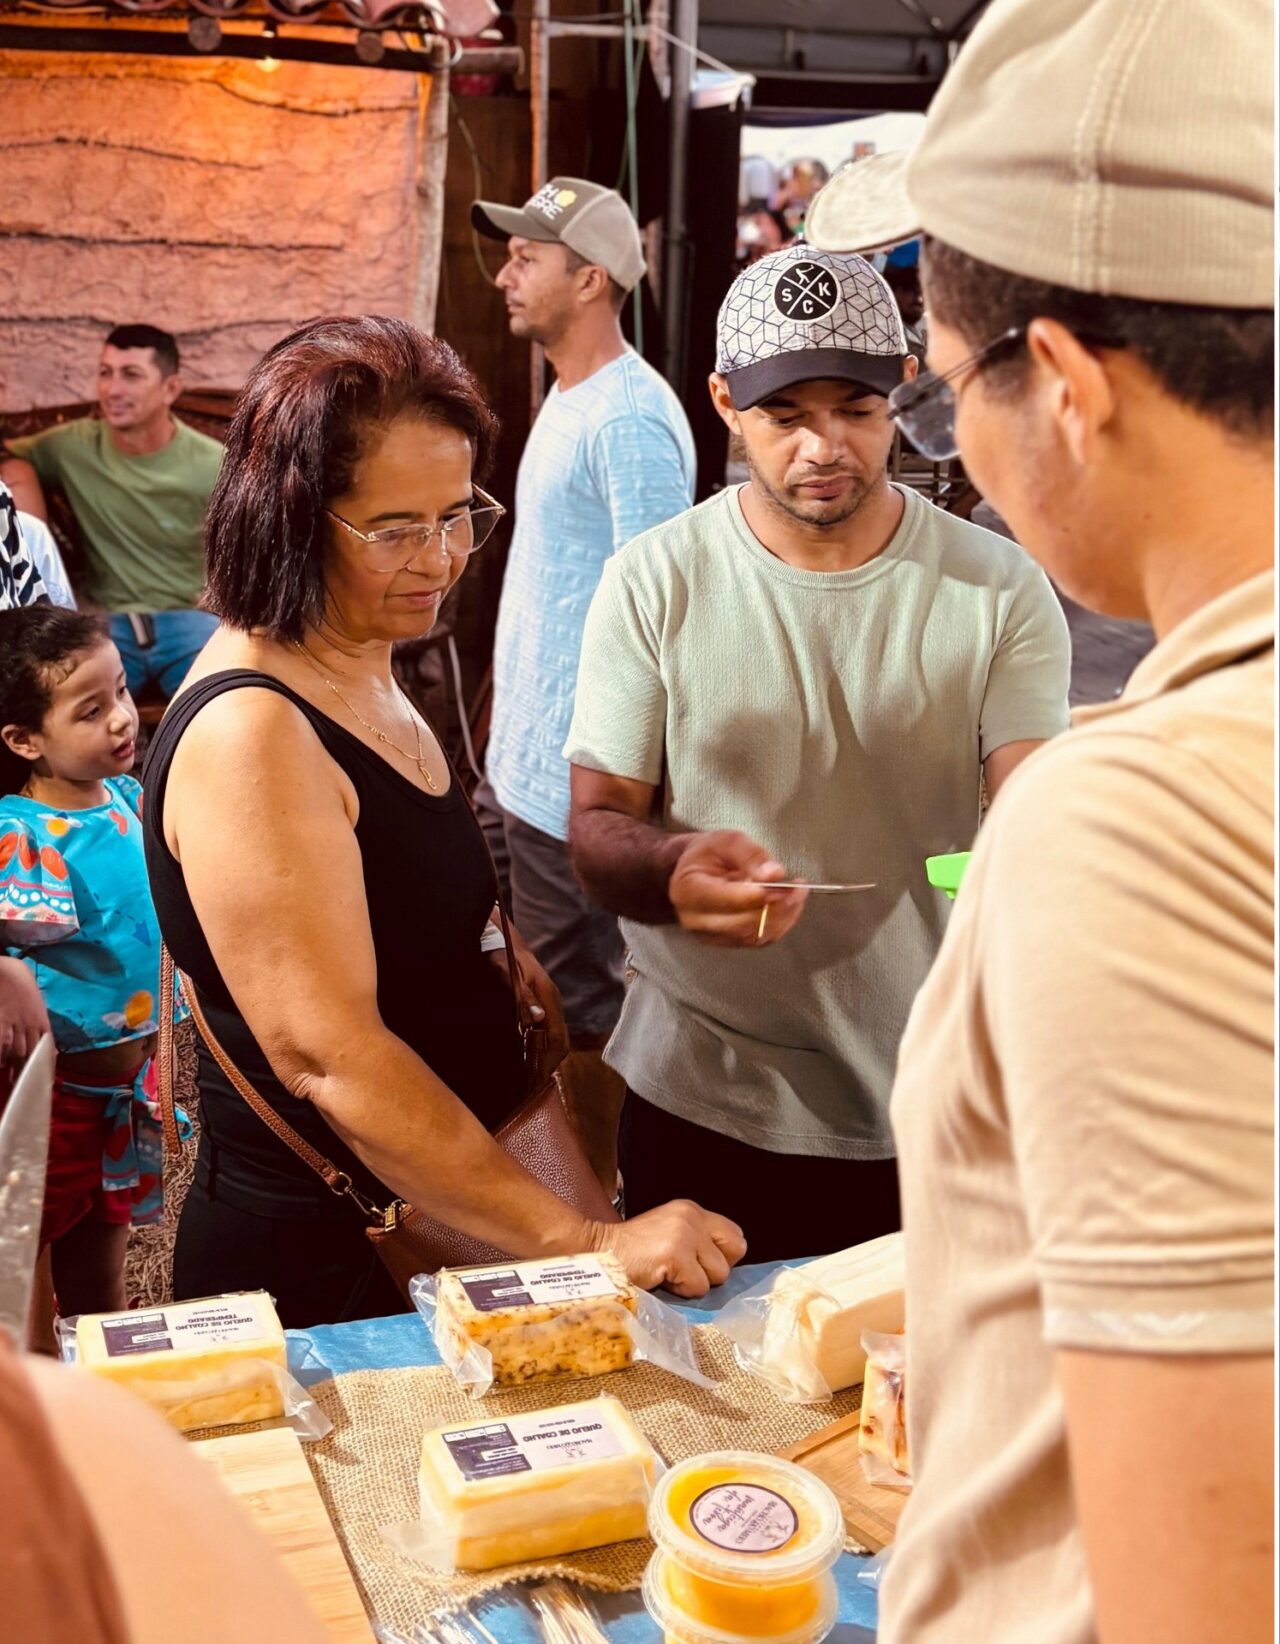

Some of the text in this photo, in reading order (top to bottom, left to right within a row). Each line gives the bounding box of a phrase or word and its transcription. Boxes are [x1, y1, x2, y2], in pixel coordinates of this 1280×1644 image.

[781, 288, 793, 302] S
[818, 282, 831, 297] K
[802, 299, 814, 314] C
[571, 1423, 603, 1434] QUEIJO
[522, 1431, 558, 1442] COALHO
